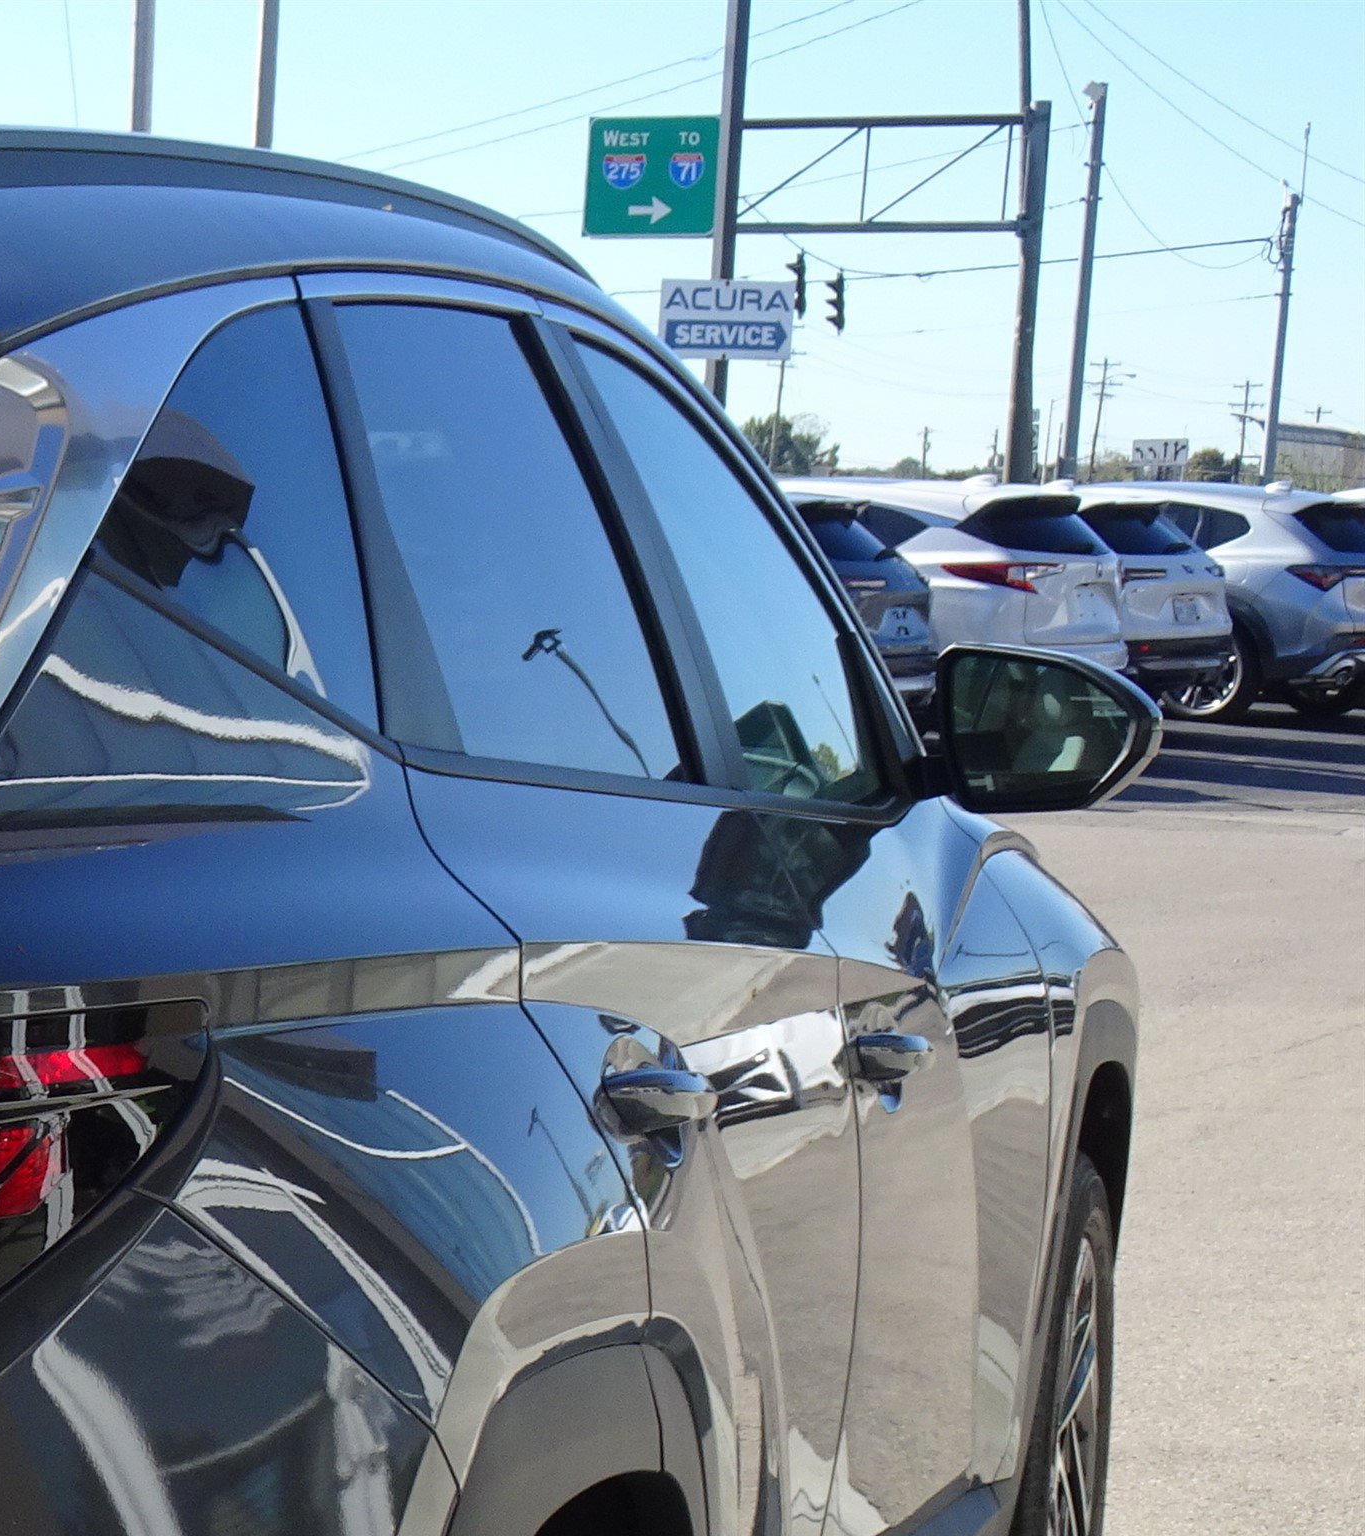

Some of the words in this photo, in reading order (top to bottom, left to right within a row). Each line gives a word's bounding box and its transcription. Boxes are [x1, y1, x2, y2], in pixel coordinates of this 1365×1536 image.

[603, 130, 649, 146] WEST
[679, 131, 701, 146] TO
[607, 162, 641, 181] 275
[677, 162, 699, 182] 71
[664, 286, 790, 312] ACURA
[674, 323, 777, 347] SERVICE
